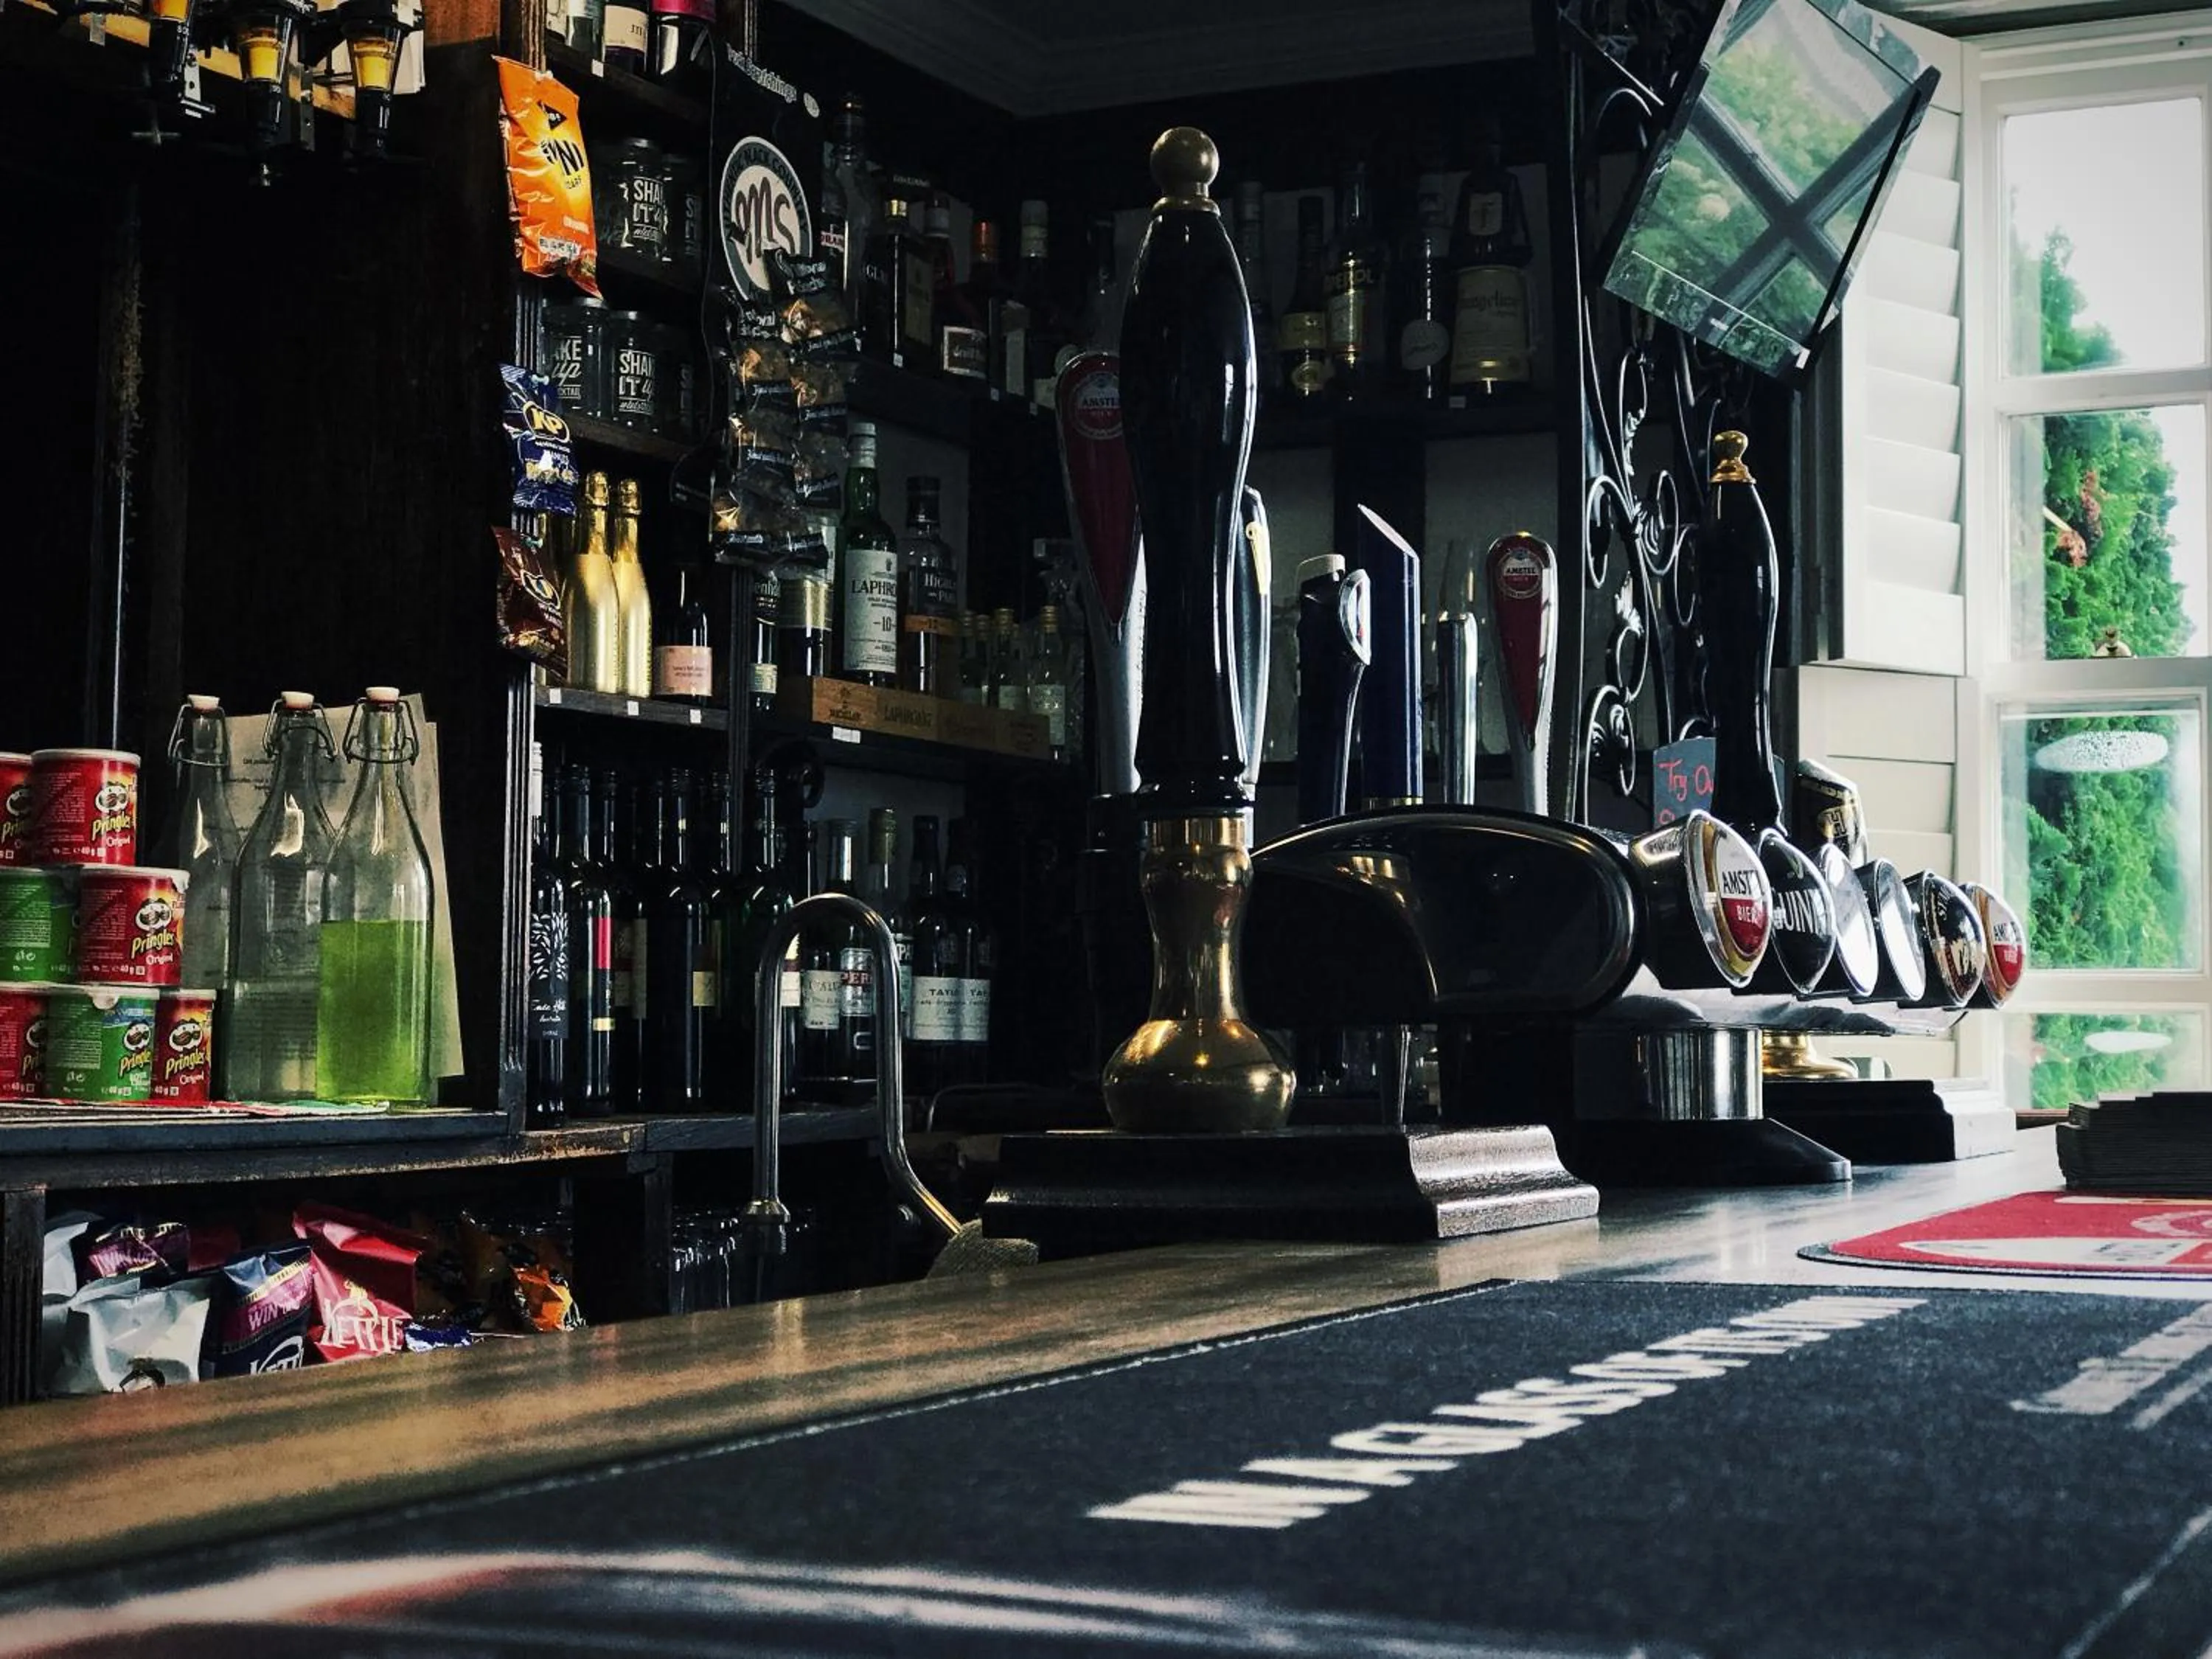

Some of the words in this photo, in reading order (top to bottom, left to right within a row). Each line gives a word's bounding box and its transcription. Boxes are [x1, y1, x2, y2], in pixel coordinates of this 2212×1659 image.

[530, 407, 563, 434] KP
[1658, 759, 1688, 802] Try
[320, 1296, 405, 1357] KETTLE
[1088, 1481, 1368, 1528] IN
[1332, 1377, 1675, 1455] GLASS
